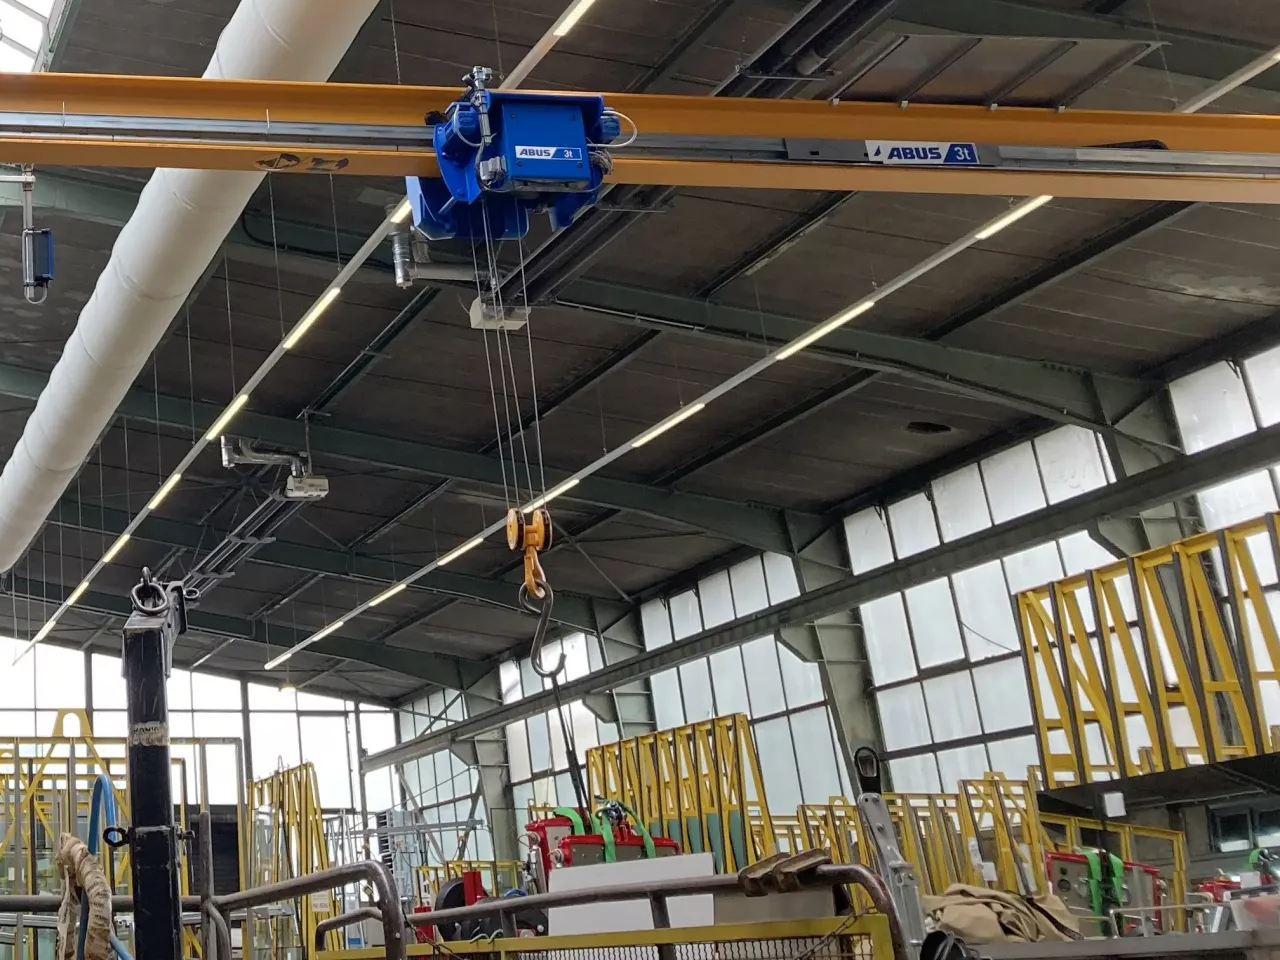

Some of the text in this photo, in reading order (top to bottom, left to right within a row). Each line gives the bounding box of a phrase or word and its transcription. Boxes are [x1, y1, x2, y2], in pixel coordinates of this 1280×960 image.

[520, 148, 573, 158] ABUS 3t
[888, 146, 971, 160] ABUS 3t
